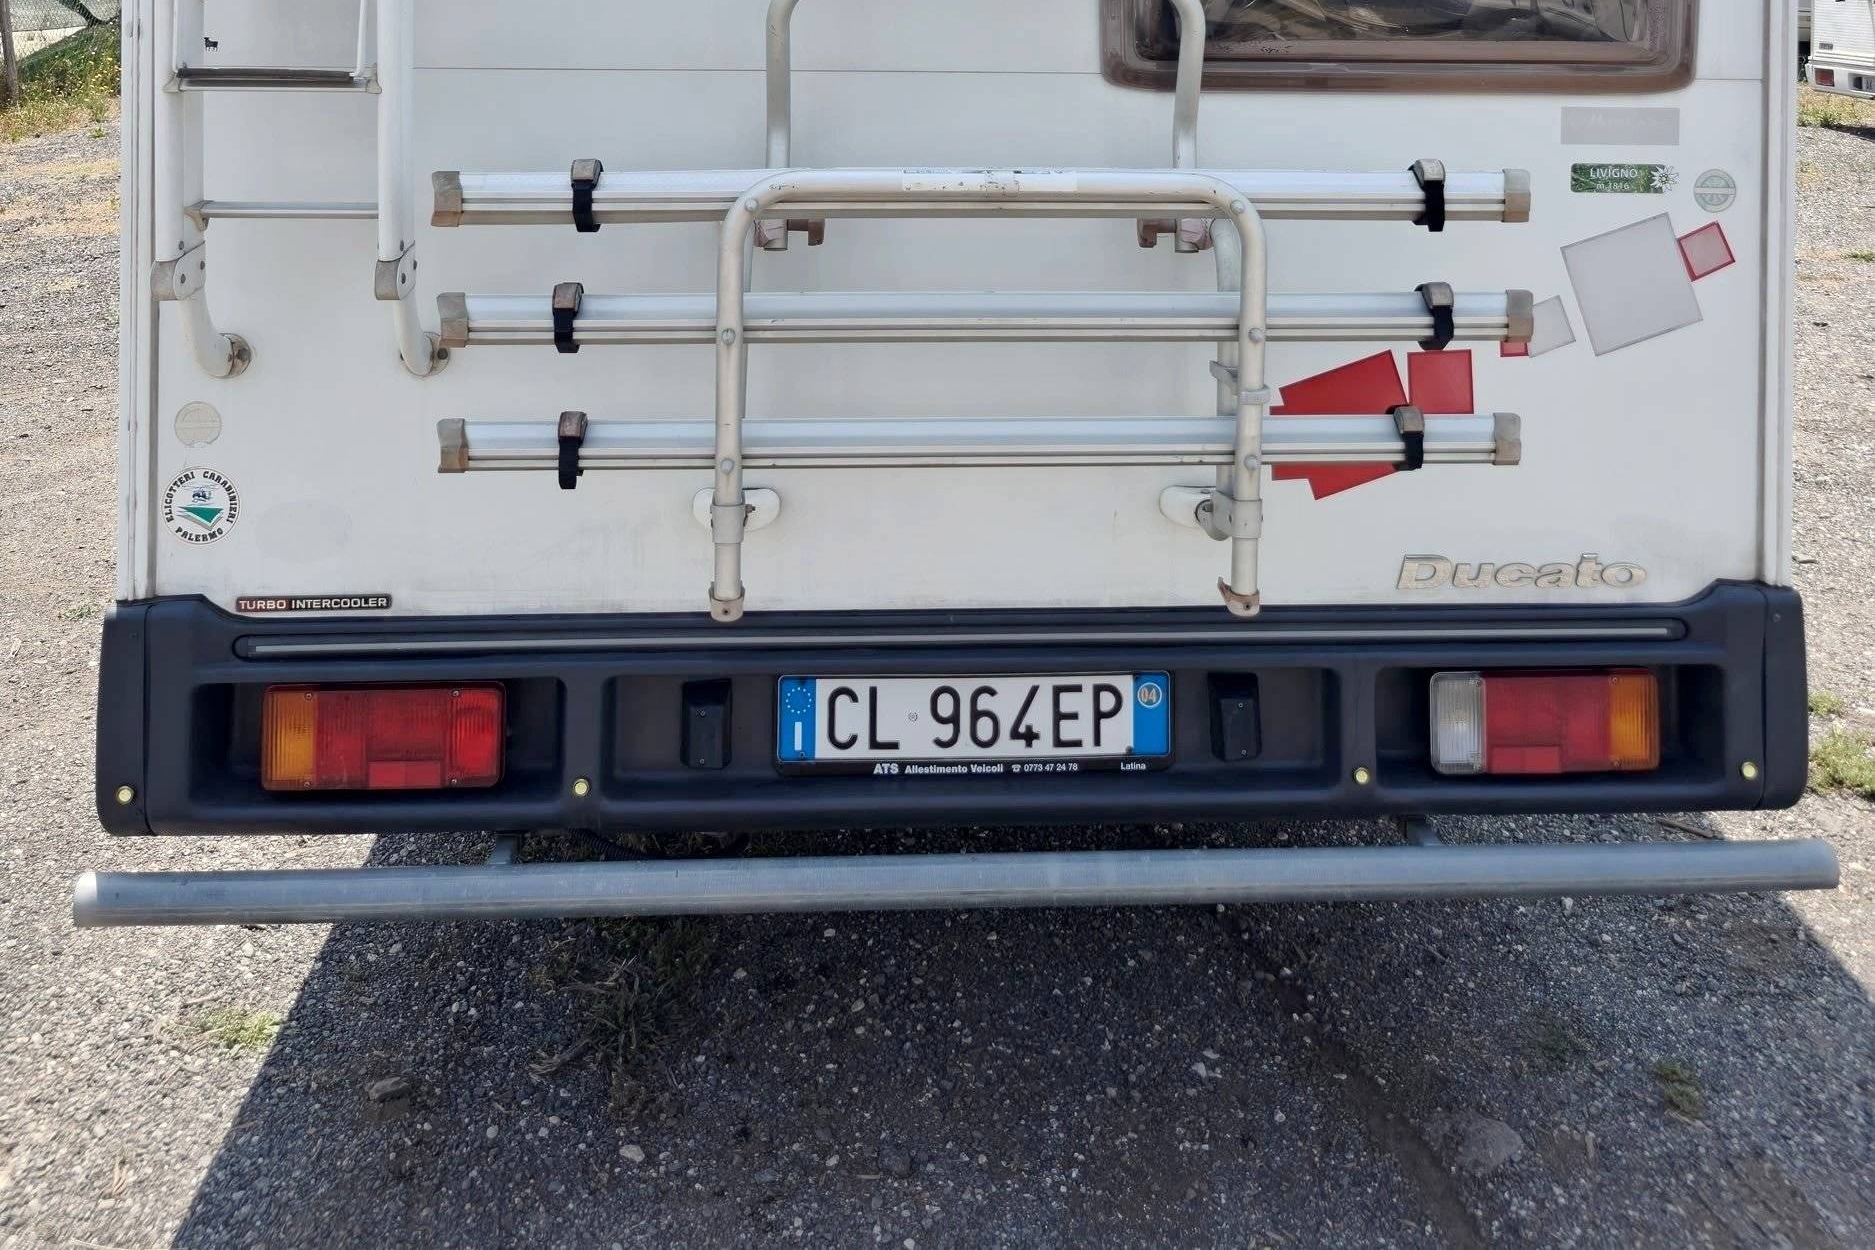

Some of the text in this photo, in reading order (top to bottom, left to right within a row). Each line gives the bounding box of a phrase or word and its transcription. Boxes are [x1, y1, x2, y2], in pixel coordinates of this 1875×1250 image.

[1589, 167, 1638, 179] LIVIGNO
[164, 470, 238, 524] ELICOTTERI CARABINIERI
[175, 526, 224, 542] PALERMO
[1396, 553, 1648, 591] Ducato
[239, 597, 388, 610] TURBO INTERCOOLER
[1138, 686, 1158, 704] 04
[827, 683, 1124, 751] CL 964EP
[873, 760, 1146, 775] ATS Allestimento Veicoli 0773 47 24 78 Latina
